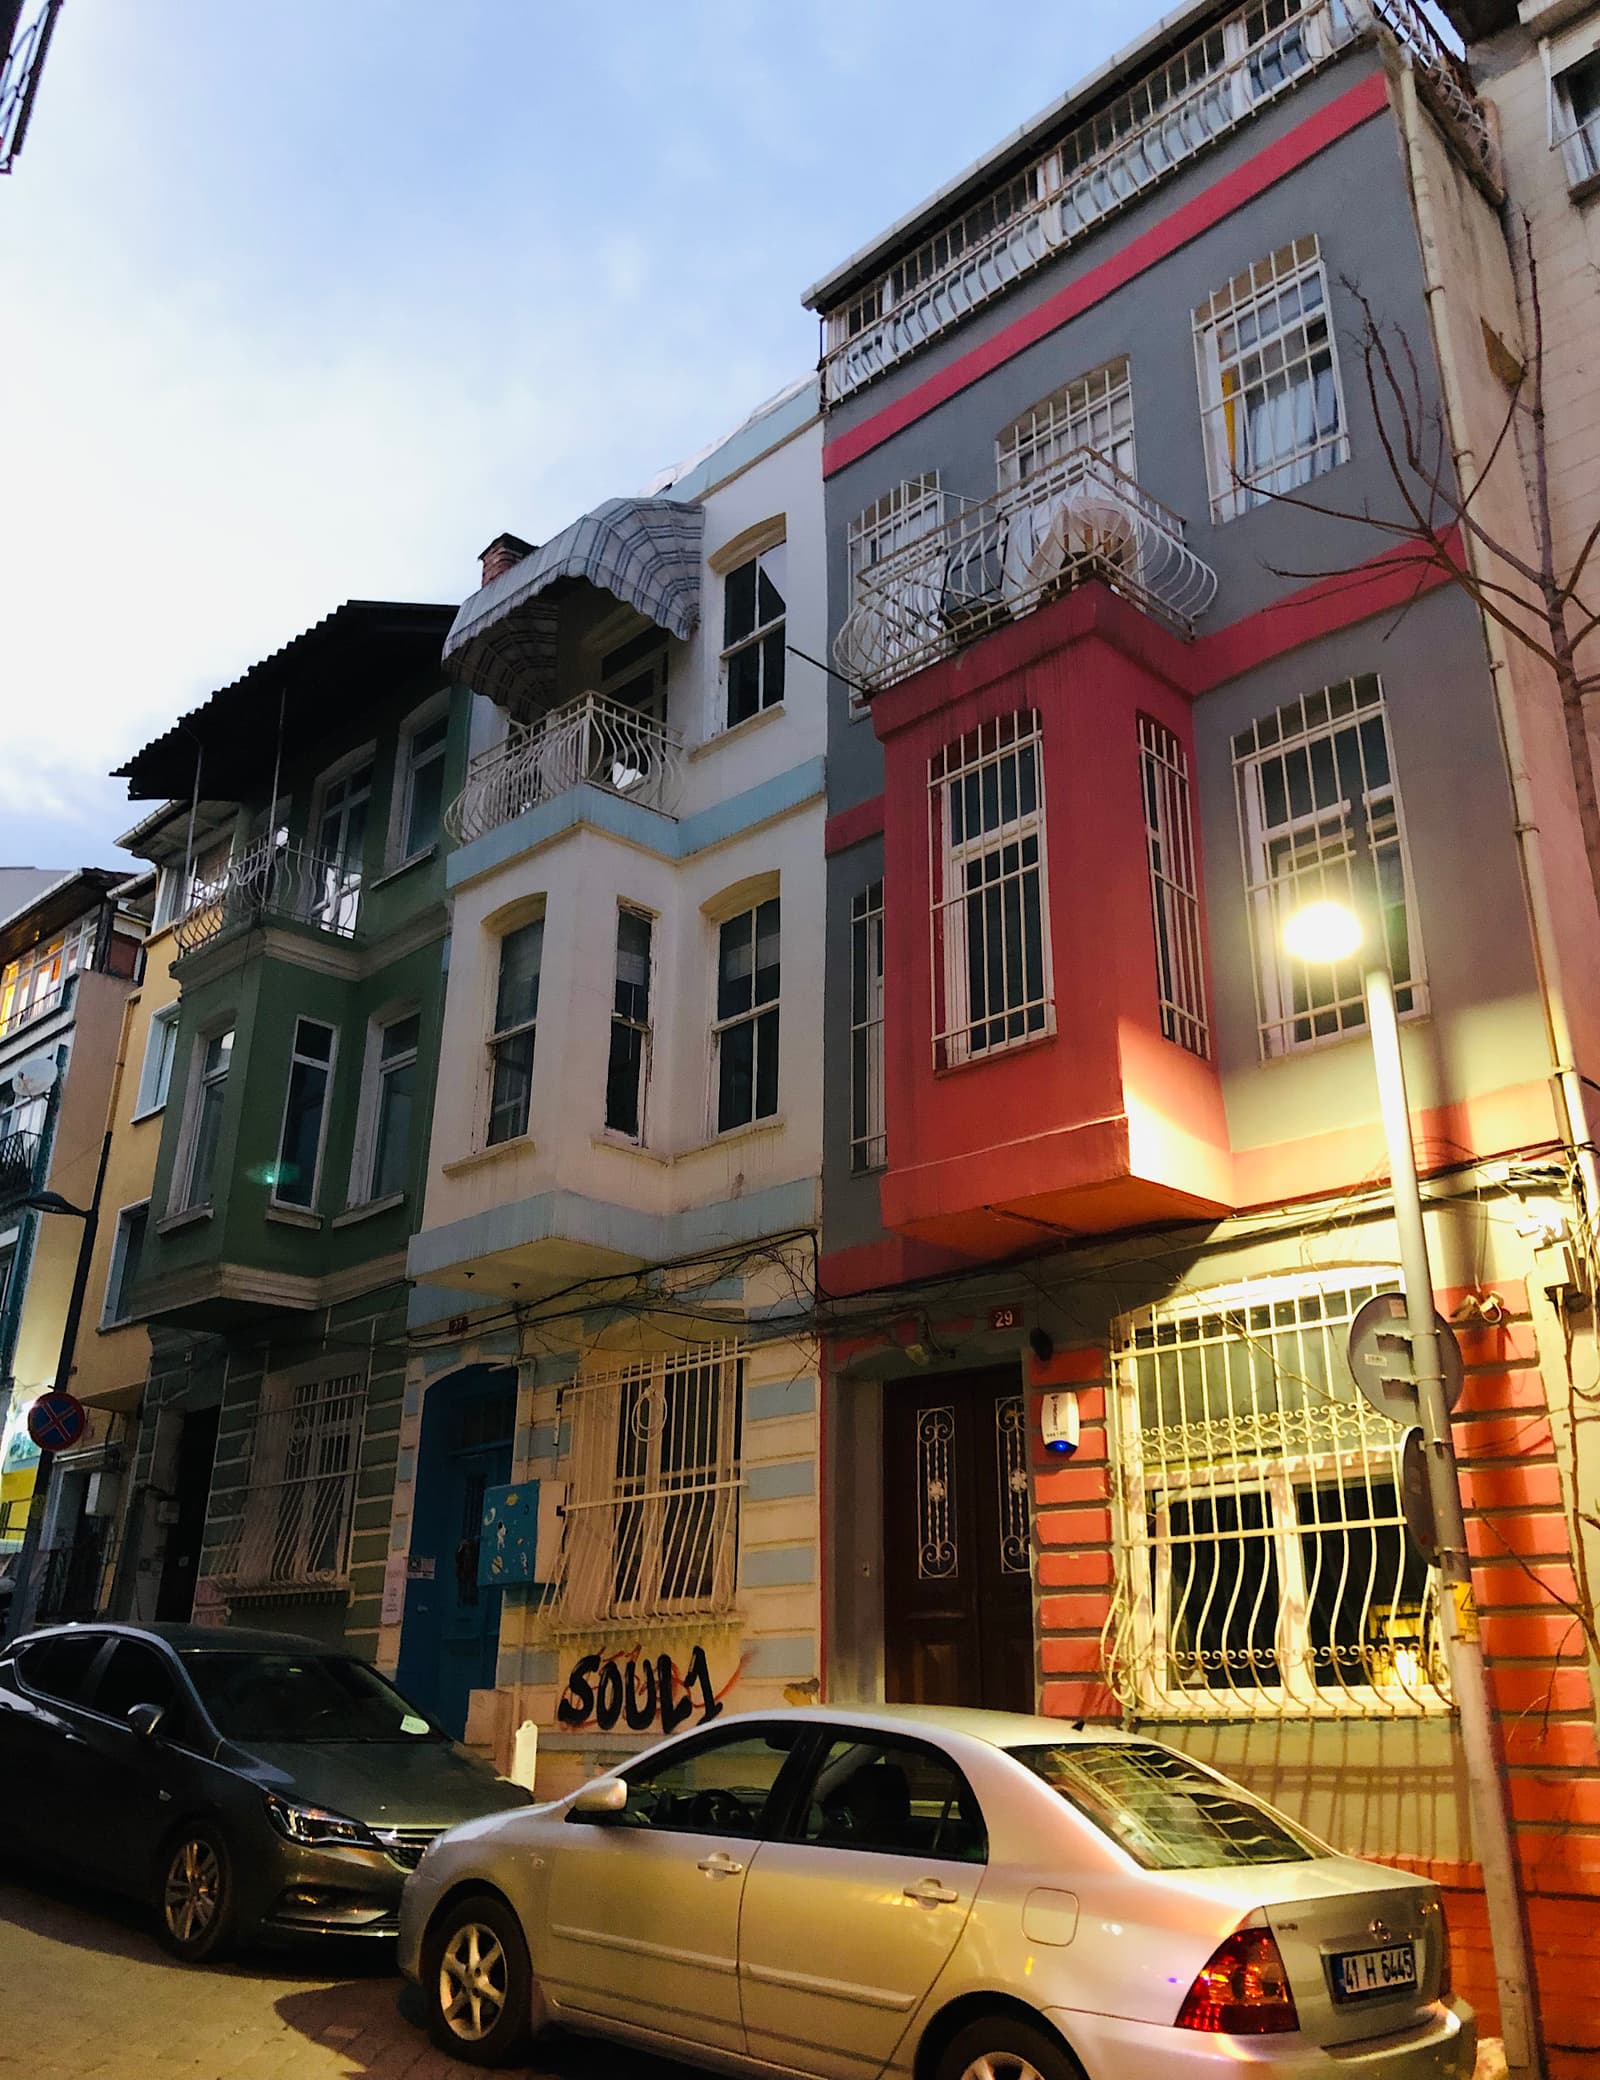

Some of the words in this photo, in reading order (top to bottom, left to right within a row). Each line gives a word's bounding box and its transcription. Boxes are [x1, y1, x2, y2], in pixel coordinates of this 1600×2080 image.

[995, 1310, 1013, 1327] 29
[1346, 1958, 1359, 1989] 41
[1365, 1956, 1377, 1986] H
[1381, 1949, 1413, 1983] 6445
